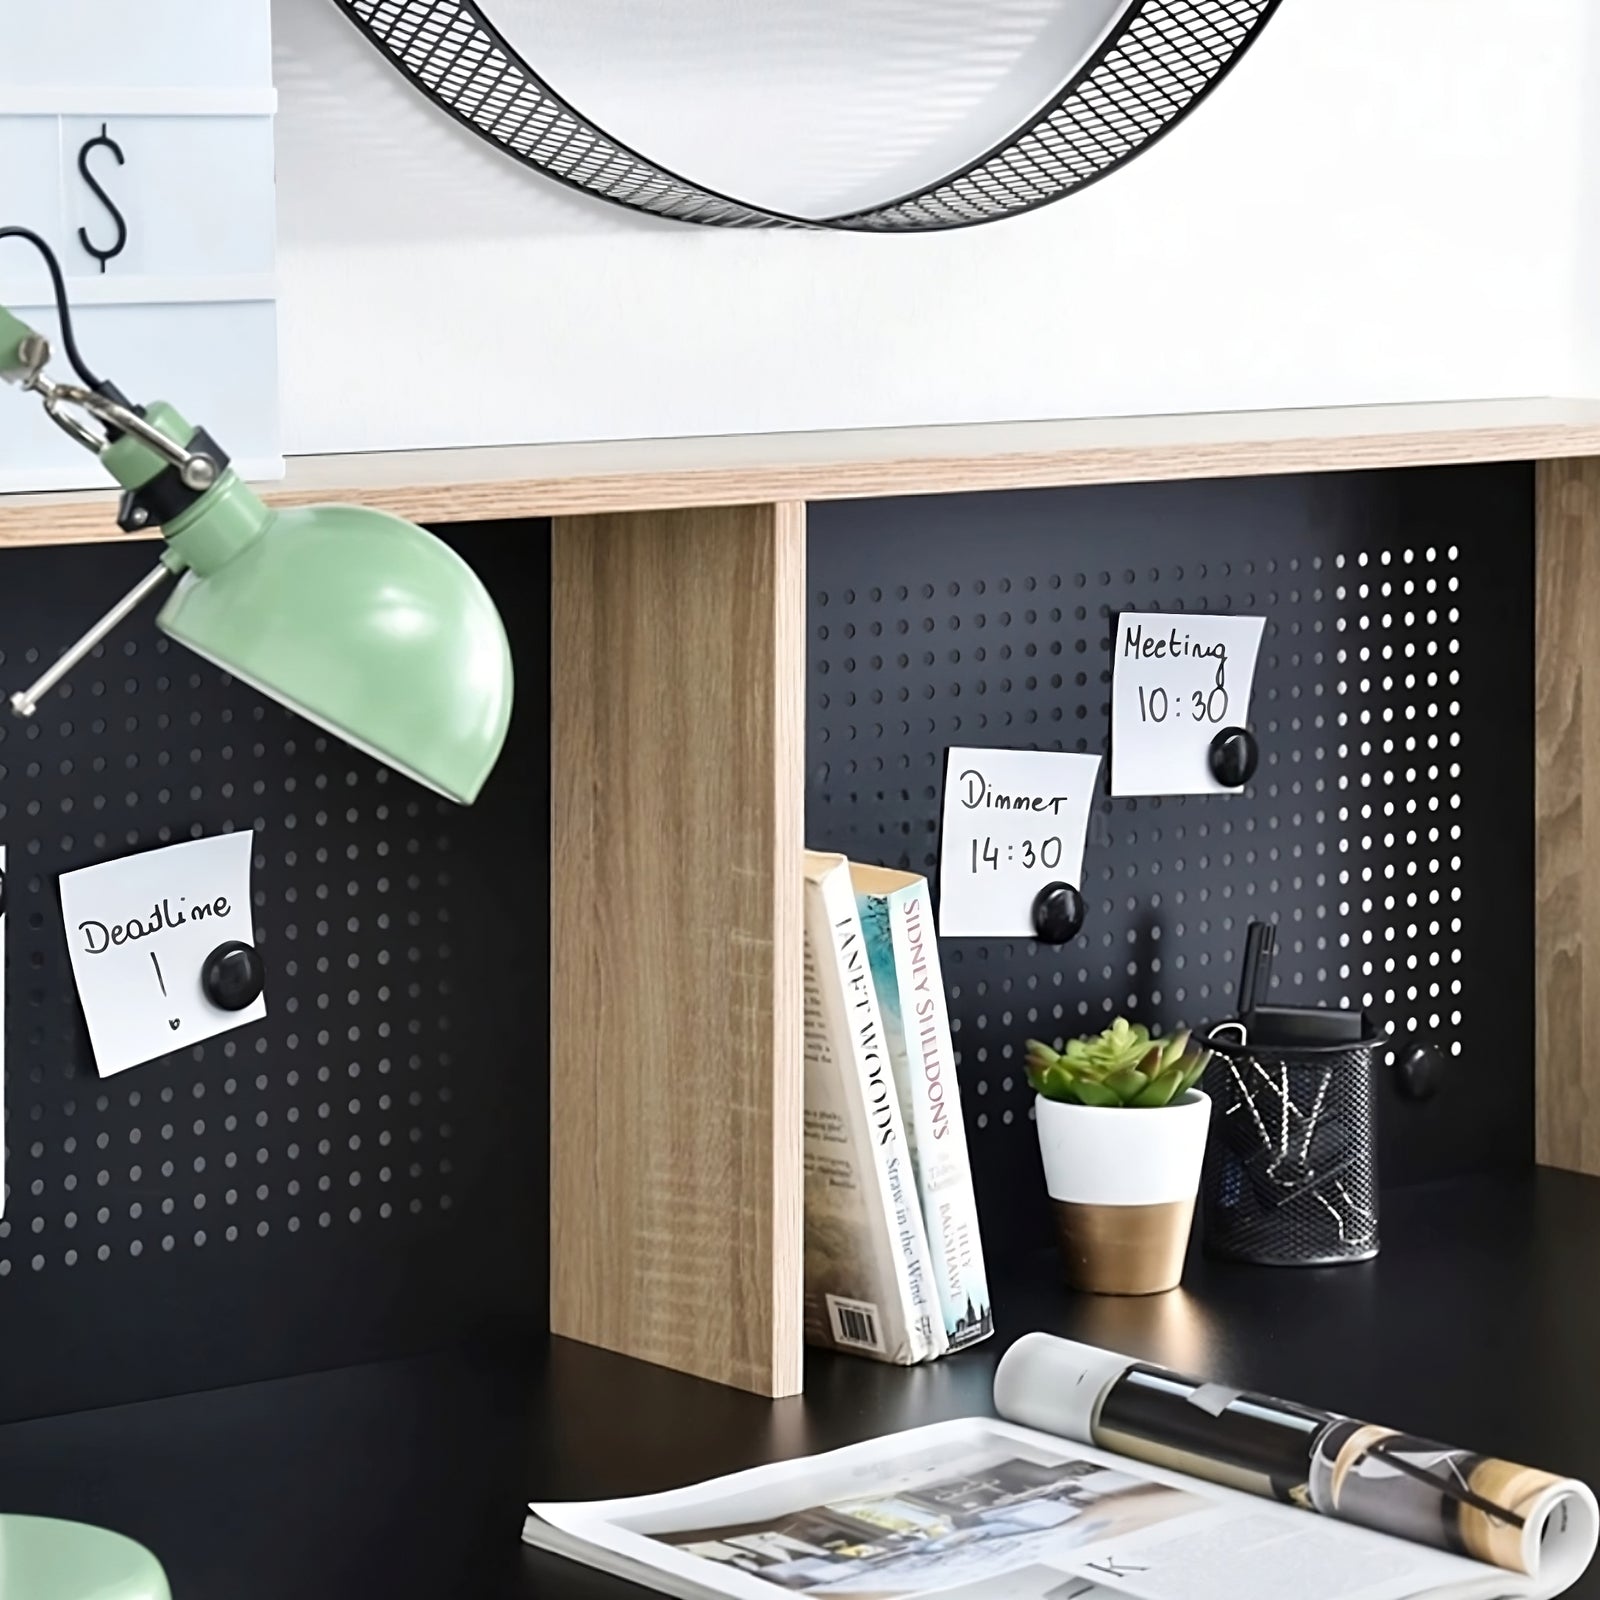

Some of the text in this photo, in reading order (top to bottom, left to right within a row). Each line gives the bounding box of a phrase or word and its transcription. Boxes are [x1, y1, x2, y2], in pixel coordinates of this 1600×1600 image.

[1124, 624, 1228, 688] Meeting
[1138, 685, 1229, 723] 10:30
[971, 836, 1063, 874] 14:30
[78, 896, 232, 955] Deadline
[860, 1021, 896, 1146] WOODS
[899, 1229, 916, 1257] the
